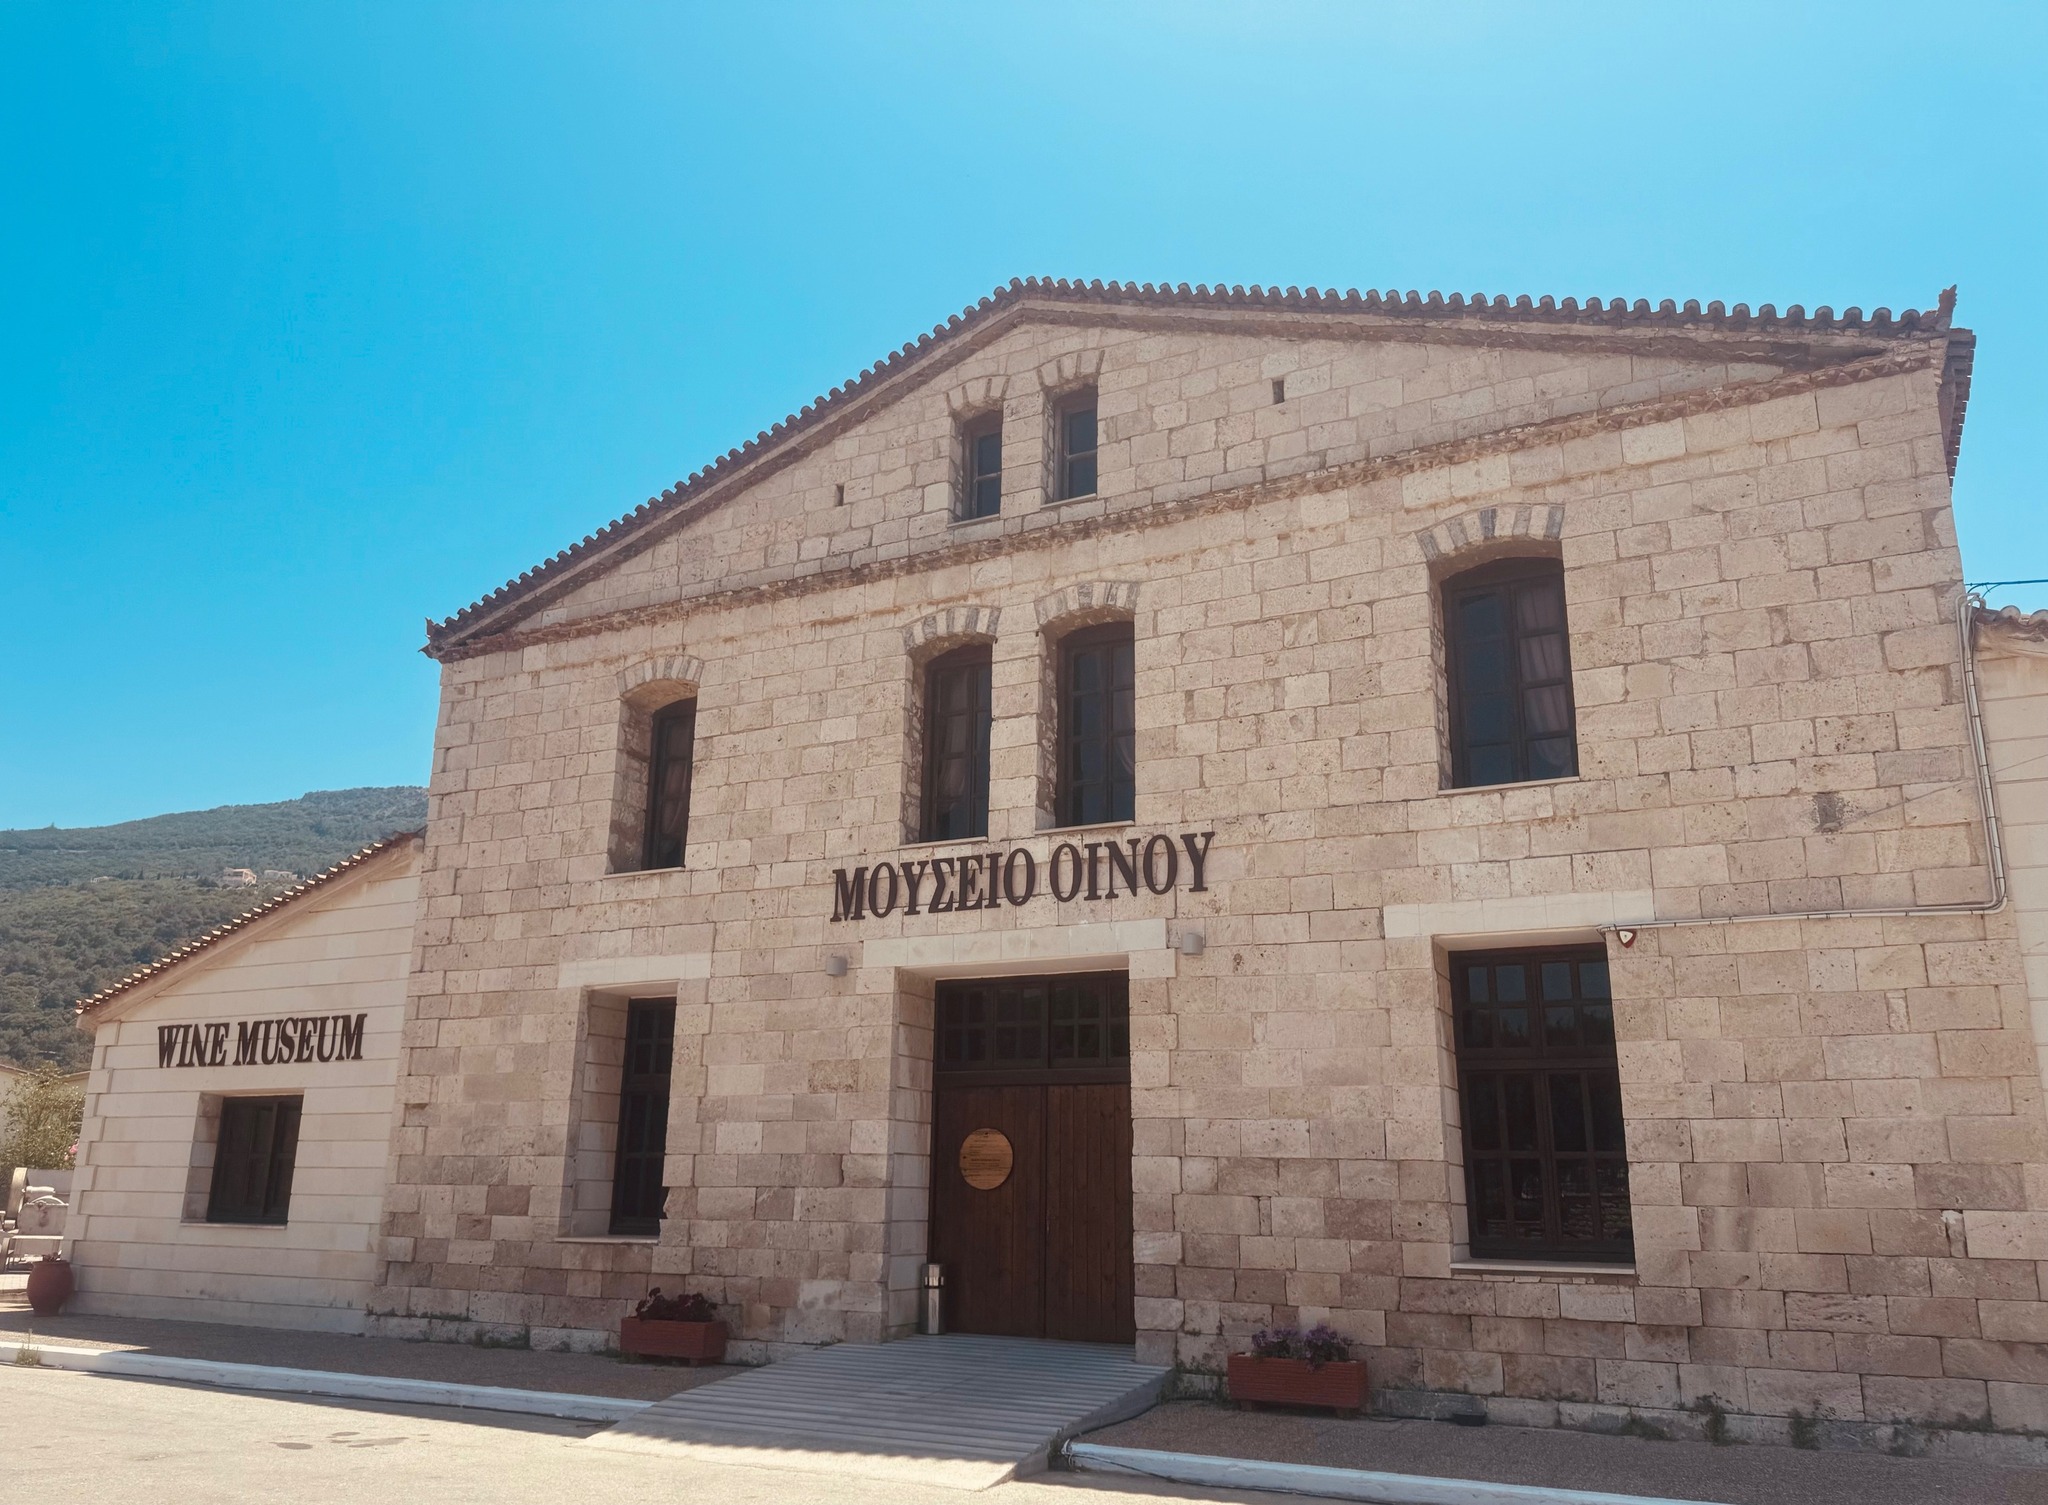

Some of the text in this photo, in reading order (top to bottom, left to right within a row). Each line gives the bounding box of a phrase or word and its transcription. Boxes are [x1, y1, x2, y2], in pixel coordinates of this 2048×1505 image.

[830, 831, 1215, 922] ΜΟΥΣΕΙΟ ΟΙΝΟΥ
[157, 1013, 368, 1068] WINE MUSEUM
